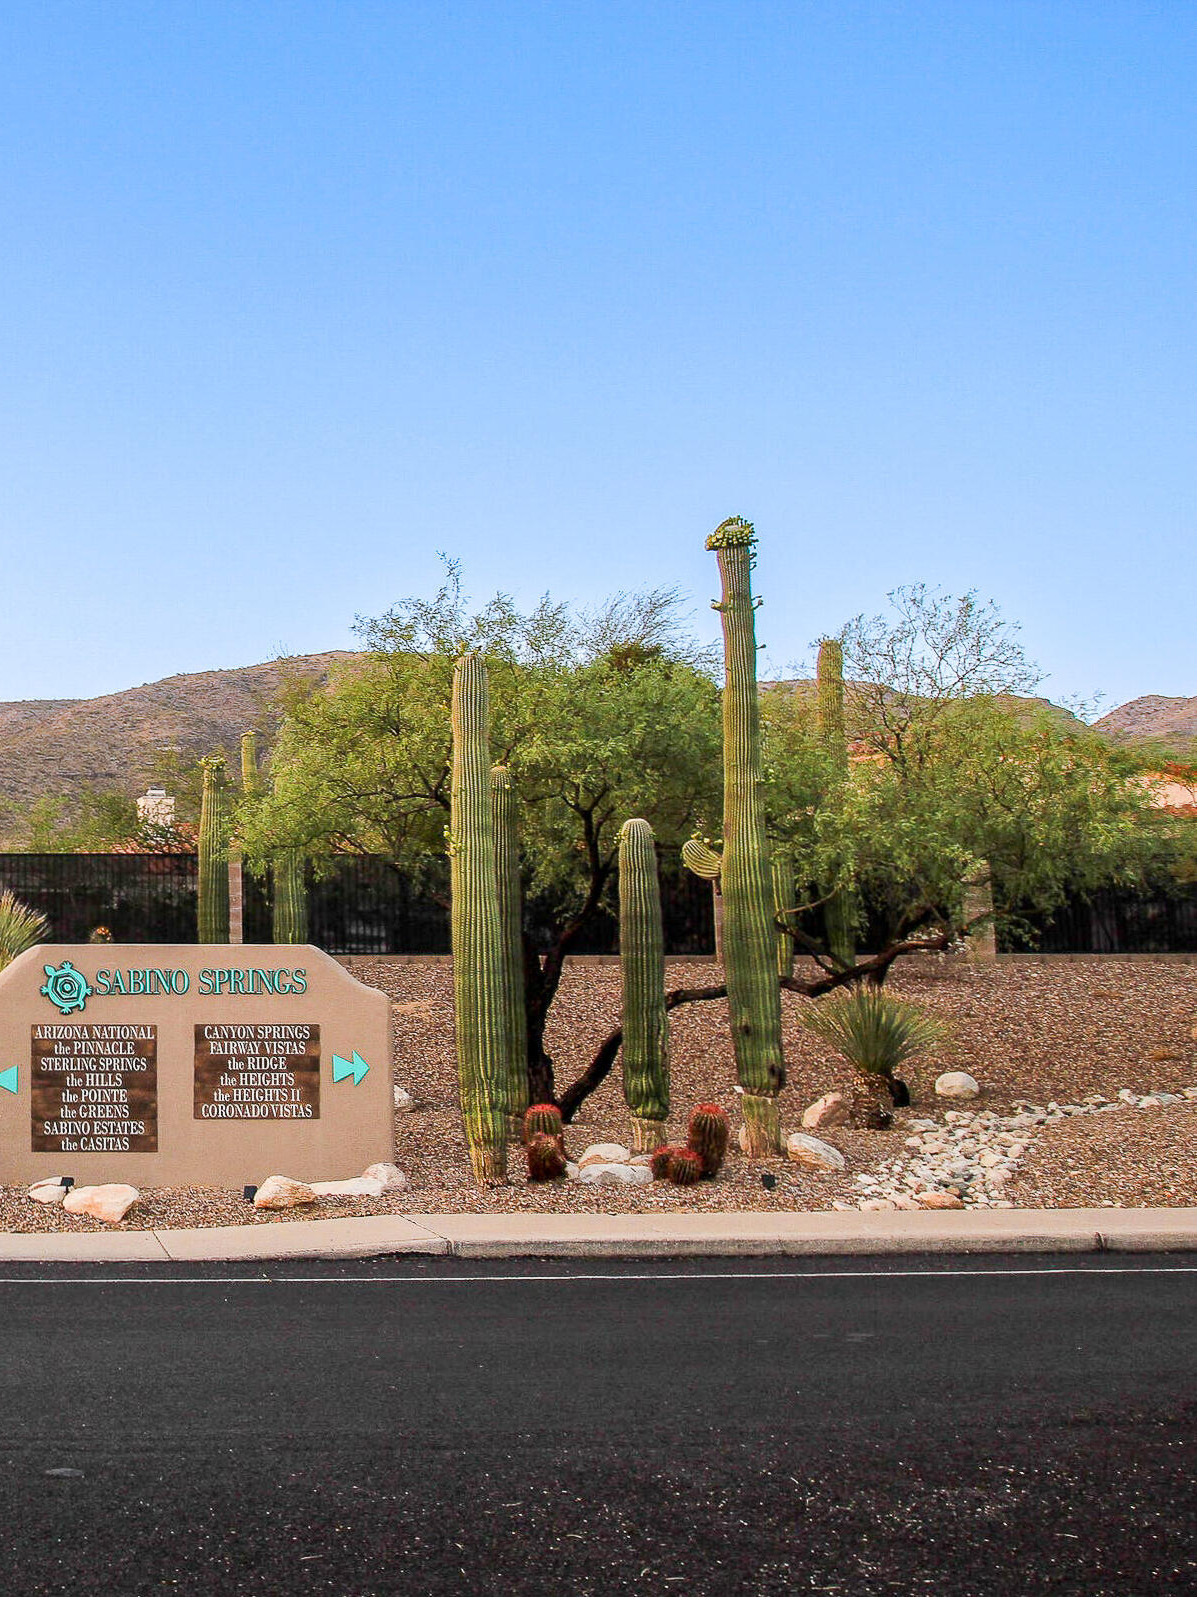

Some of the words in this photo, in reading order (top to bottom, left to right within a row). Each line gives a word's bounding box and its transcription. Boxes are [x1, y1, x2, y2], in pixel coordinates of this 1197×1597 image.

[96, 968, 189, 995] SABINO
[198, 968, 307, 995] SPRINGS
[35, 1025, 88, 1039] ARIZONA
[93, 1025, 154, 1039] NATIONAL
[204, 1026, 254, 1039] CANYON
[258, 1026, 310, 1039] SPRINGS
[54, 1042, 70, 1054] the
[74, 1041, 134, 1054] PINNACLE
[210, 1041, 261, 1054] FAIRWAY
[264, 1041, 306, 1054] VISTAS
[41, 1057, 96, 1071] STERLING
[99, 1057, 147, 1071] SPRINGS
[228, 1058, 244, 1070] the
[247, 1057, 286, 1070] RIDGE
[66, 1074, 82, 1086] the
[86, 1073, 122, 1086] HILLS
[220, 1074, 236, 1086] the
[240, 1072, 294, 1086] HEIGHTS
[62, 1090, 78, 1102] the
[81, 1089, 128, 1102] POINTE
[214, 1089, 230, 1102] the
[233, 1088, 288, 1102] HEIGHTS
[292, 1090, 300, 1102] II
[61, 1106, 76, 1118] the
[79, 1105, 130, 1118] GREENS
[202, 1104, 269, 1118] CORONADO
[269, 1104, 312, 1118] VISTAS
[44, 1121, 90, 1135] SABINO
[94, 1121, 145, 1135] ESTATES
[61, 1138, 78, 1150] the
[80, 1137, 130, 1150] CASITAS
